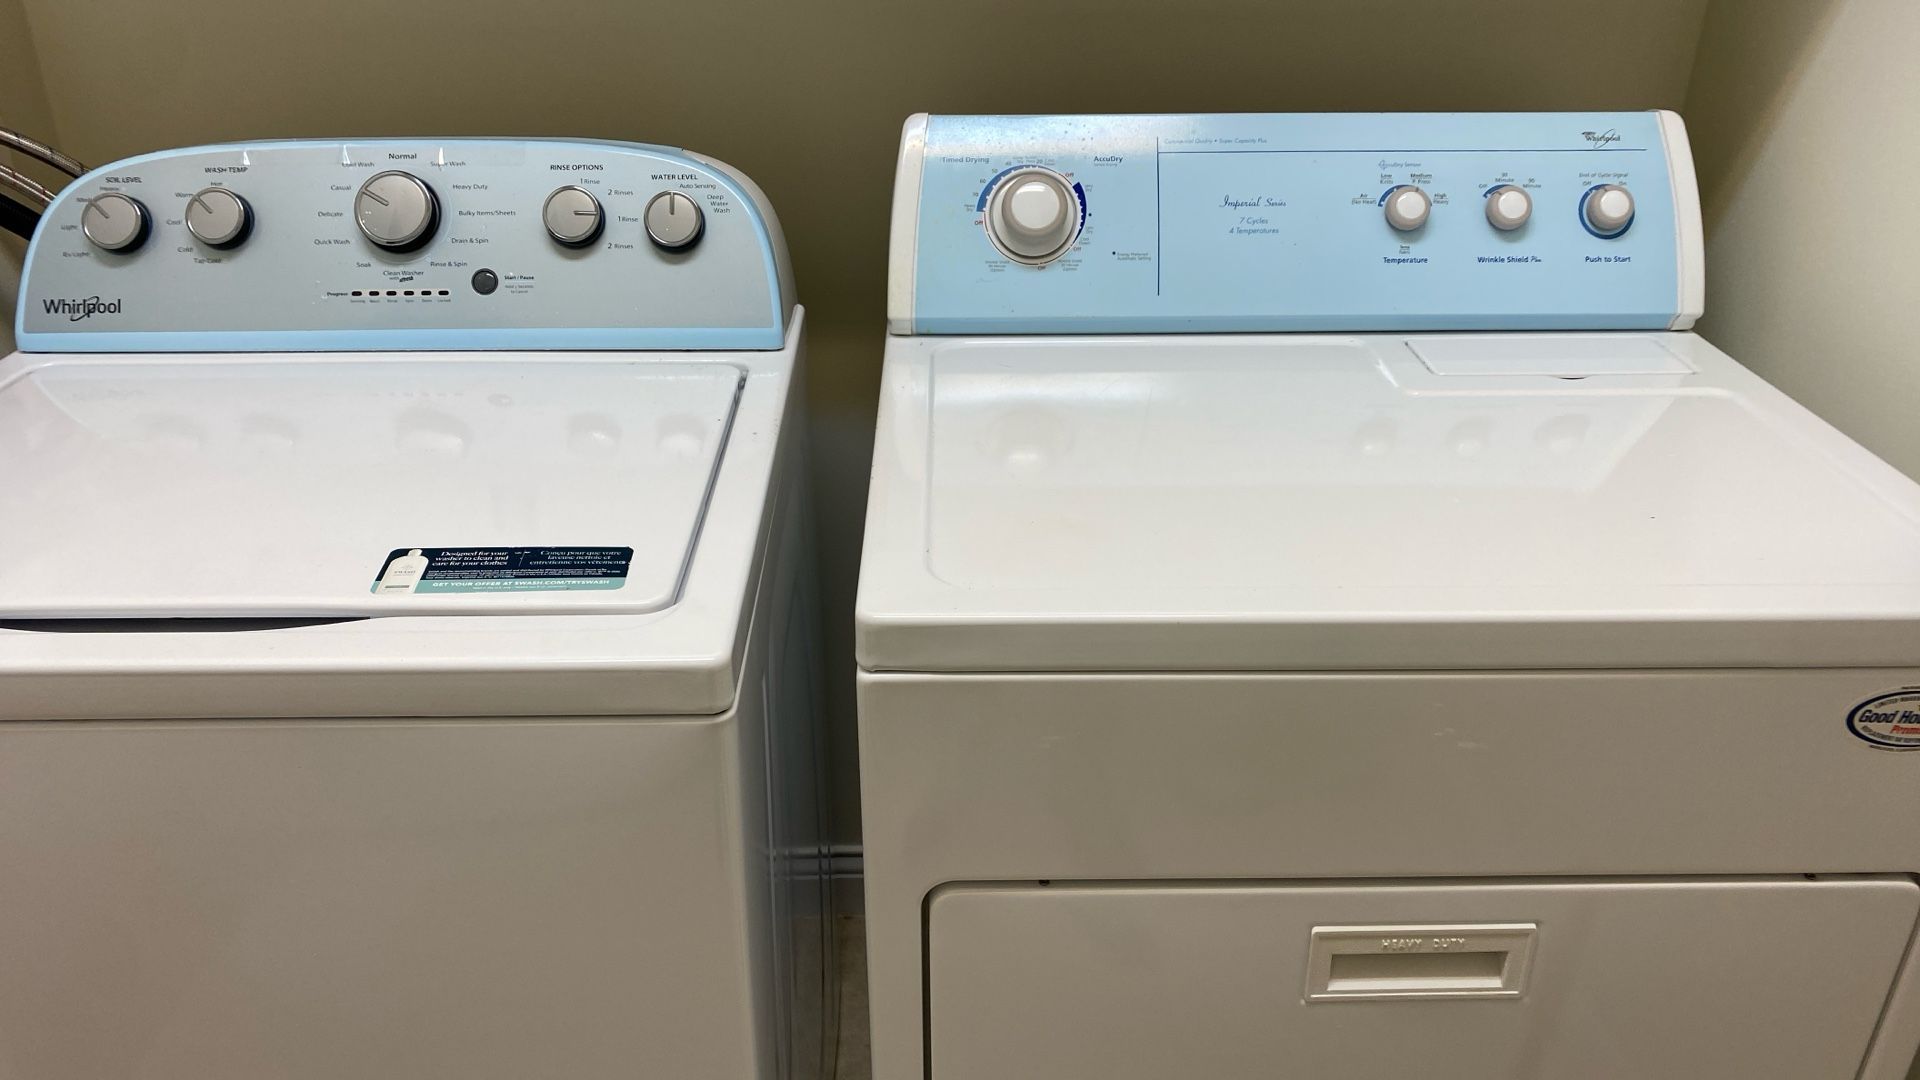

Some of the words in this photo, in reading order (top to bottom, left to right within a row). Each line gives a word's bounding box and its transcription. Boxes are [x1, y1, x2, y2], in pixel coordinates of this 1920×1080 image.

[1583, 130, 1621, 148] Whirlpool
[965, 156, 990, 164] Drying
[1094, 155, 1123, 163] AccuDry
[204, 166, 227, 174] WASH
[228, 165, 248, 173] TEMP
[1219, 194, 1262, 210] Imperial
[1264, 197, 1287, 207] Series
[1239, 217, 1245, 225] 7
[1246, 216, 1269, 225] Cycles
[1229, 226, 1235, 234] 4
[1236, 226, 1279, 236] Temperatures
[475, 237, 489, 245] Spin
[1383, 256, 1428, 265] Temperature
[43, 297, 121, 320] Whirlpool
[1858, 709, 1899, 723] Good
[1382, 937, 1423, 951] HEAVY
[1432, 937, 1466, 950] DUTY
